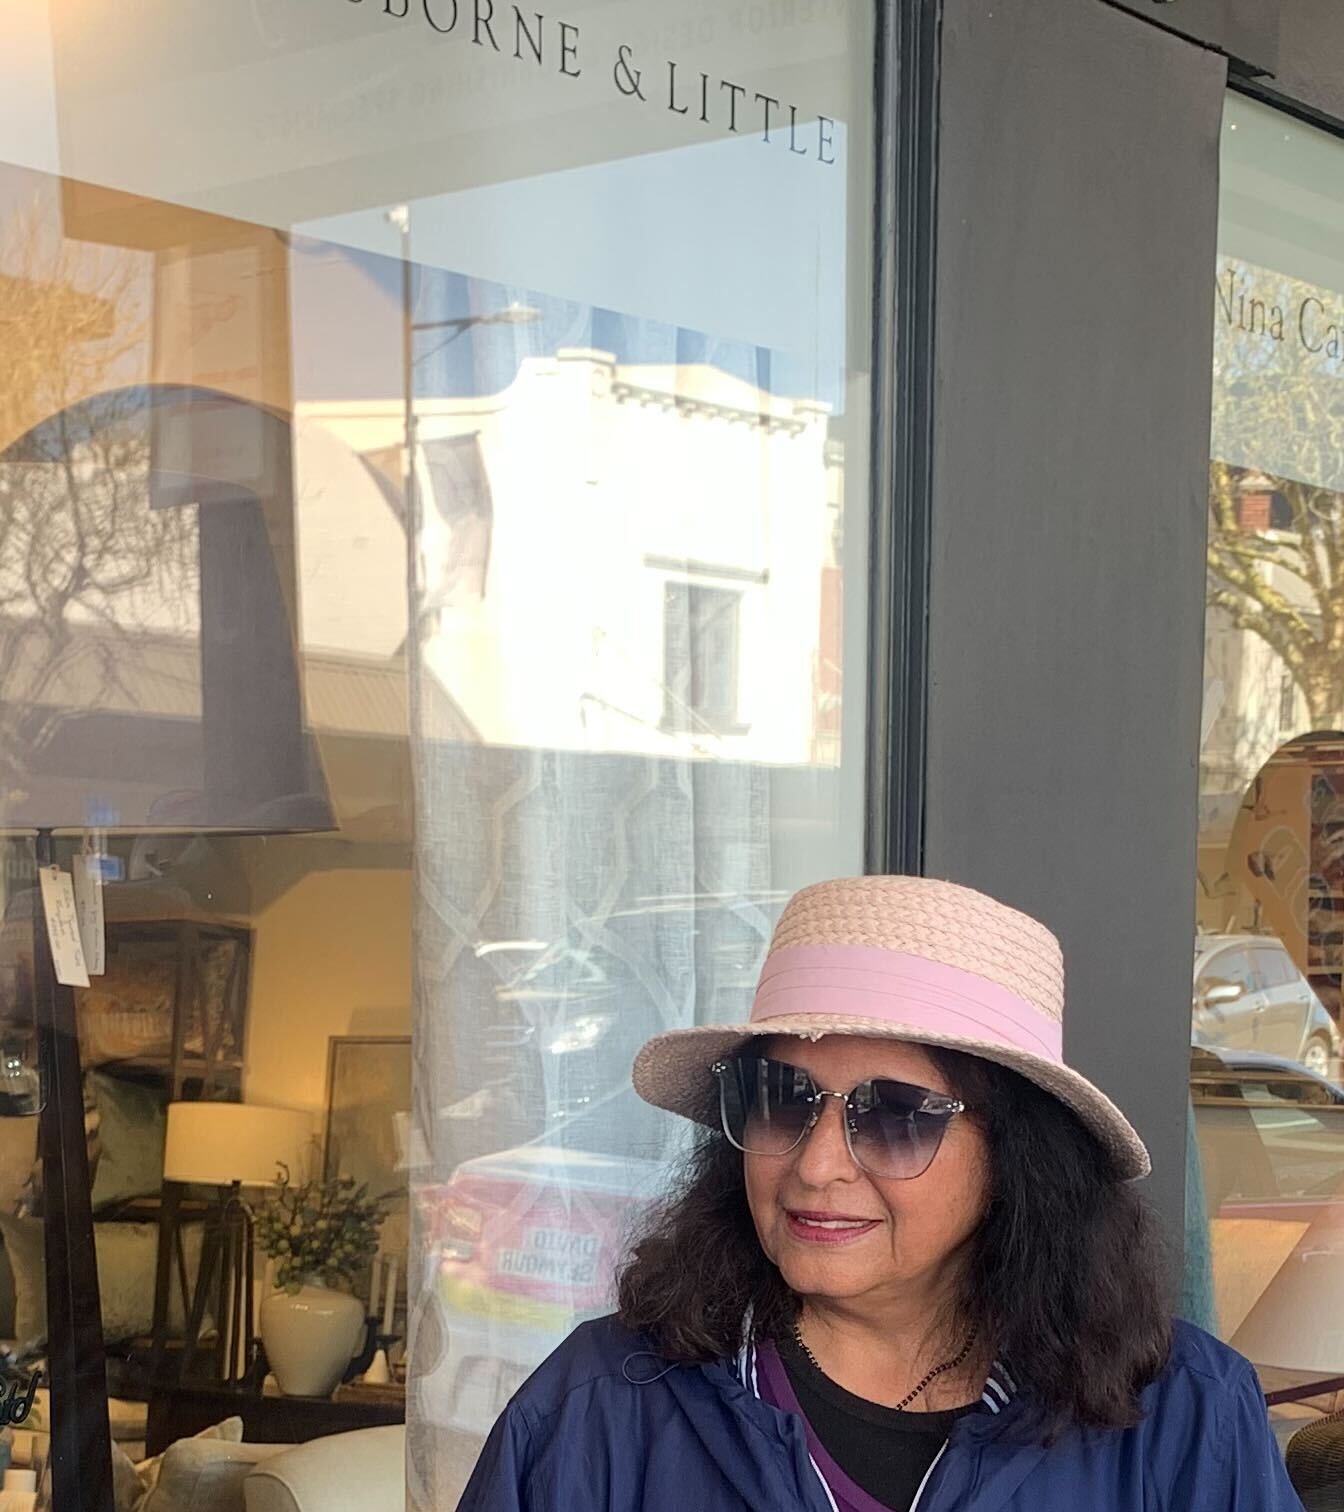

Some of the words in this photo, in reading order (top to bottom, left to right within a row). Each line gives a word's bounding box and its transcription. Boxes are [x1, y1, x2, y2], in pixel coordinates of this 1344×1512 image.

[347, 0, 582, 77] ORNE
[613, 44, 647, 102] &
[667, 60, 836, 165] LITTLE
[1215, 268, 1285, 342] Nina
